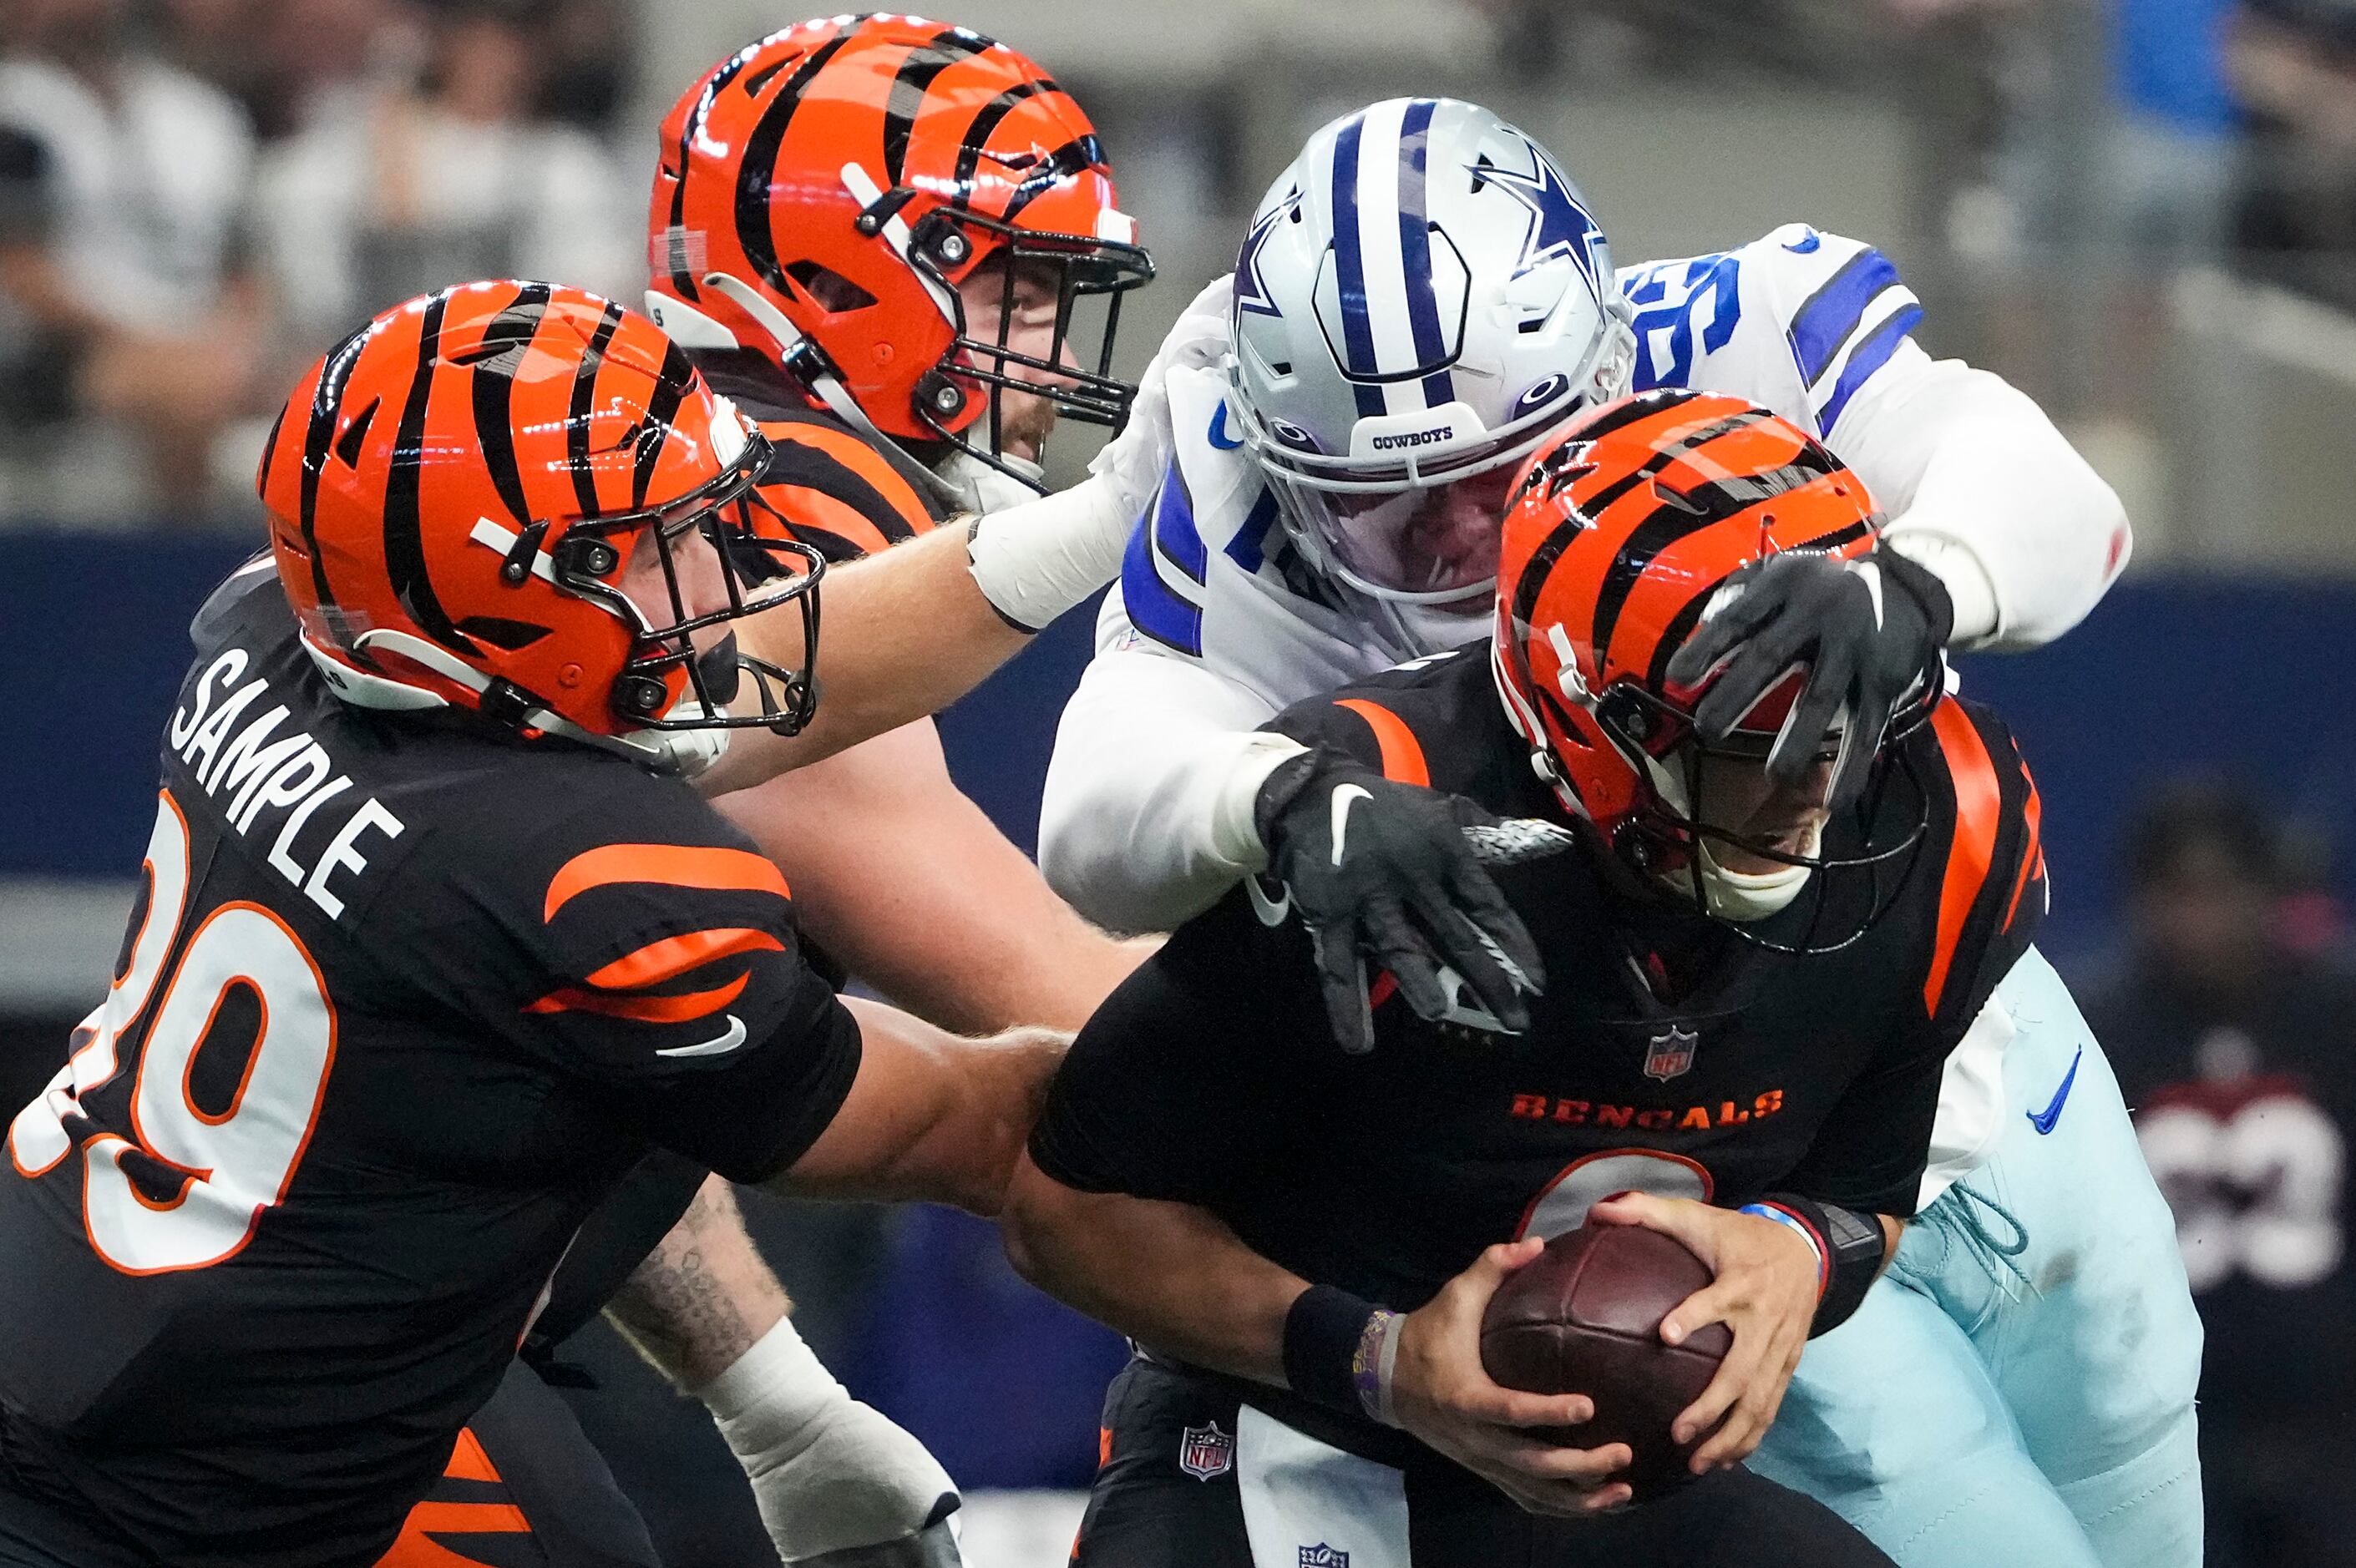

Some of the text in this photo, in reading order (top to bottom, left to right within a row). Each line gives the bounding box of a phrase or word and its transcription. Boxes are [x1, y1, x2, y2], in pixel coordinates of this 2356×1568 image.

[1372, 426, 1453, 450] COWBOYS
[170, 648, 406, 920] SAMPLE
[1511, 1089, 1784, 1130] BENGALS
